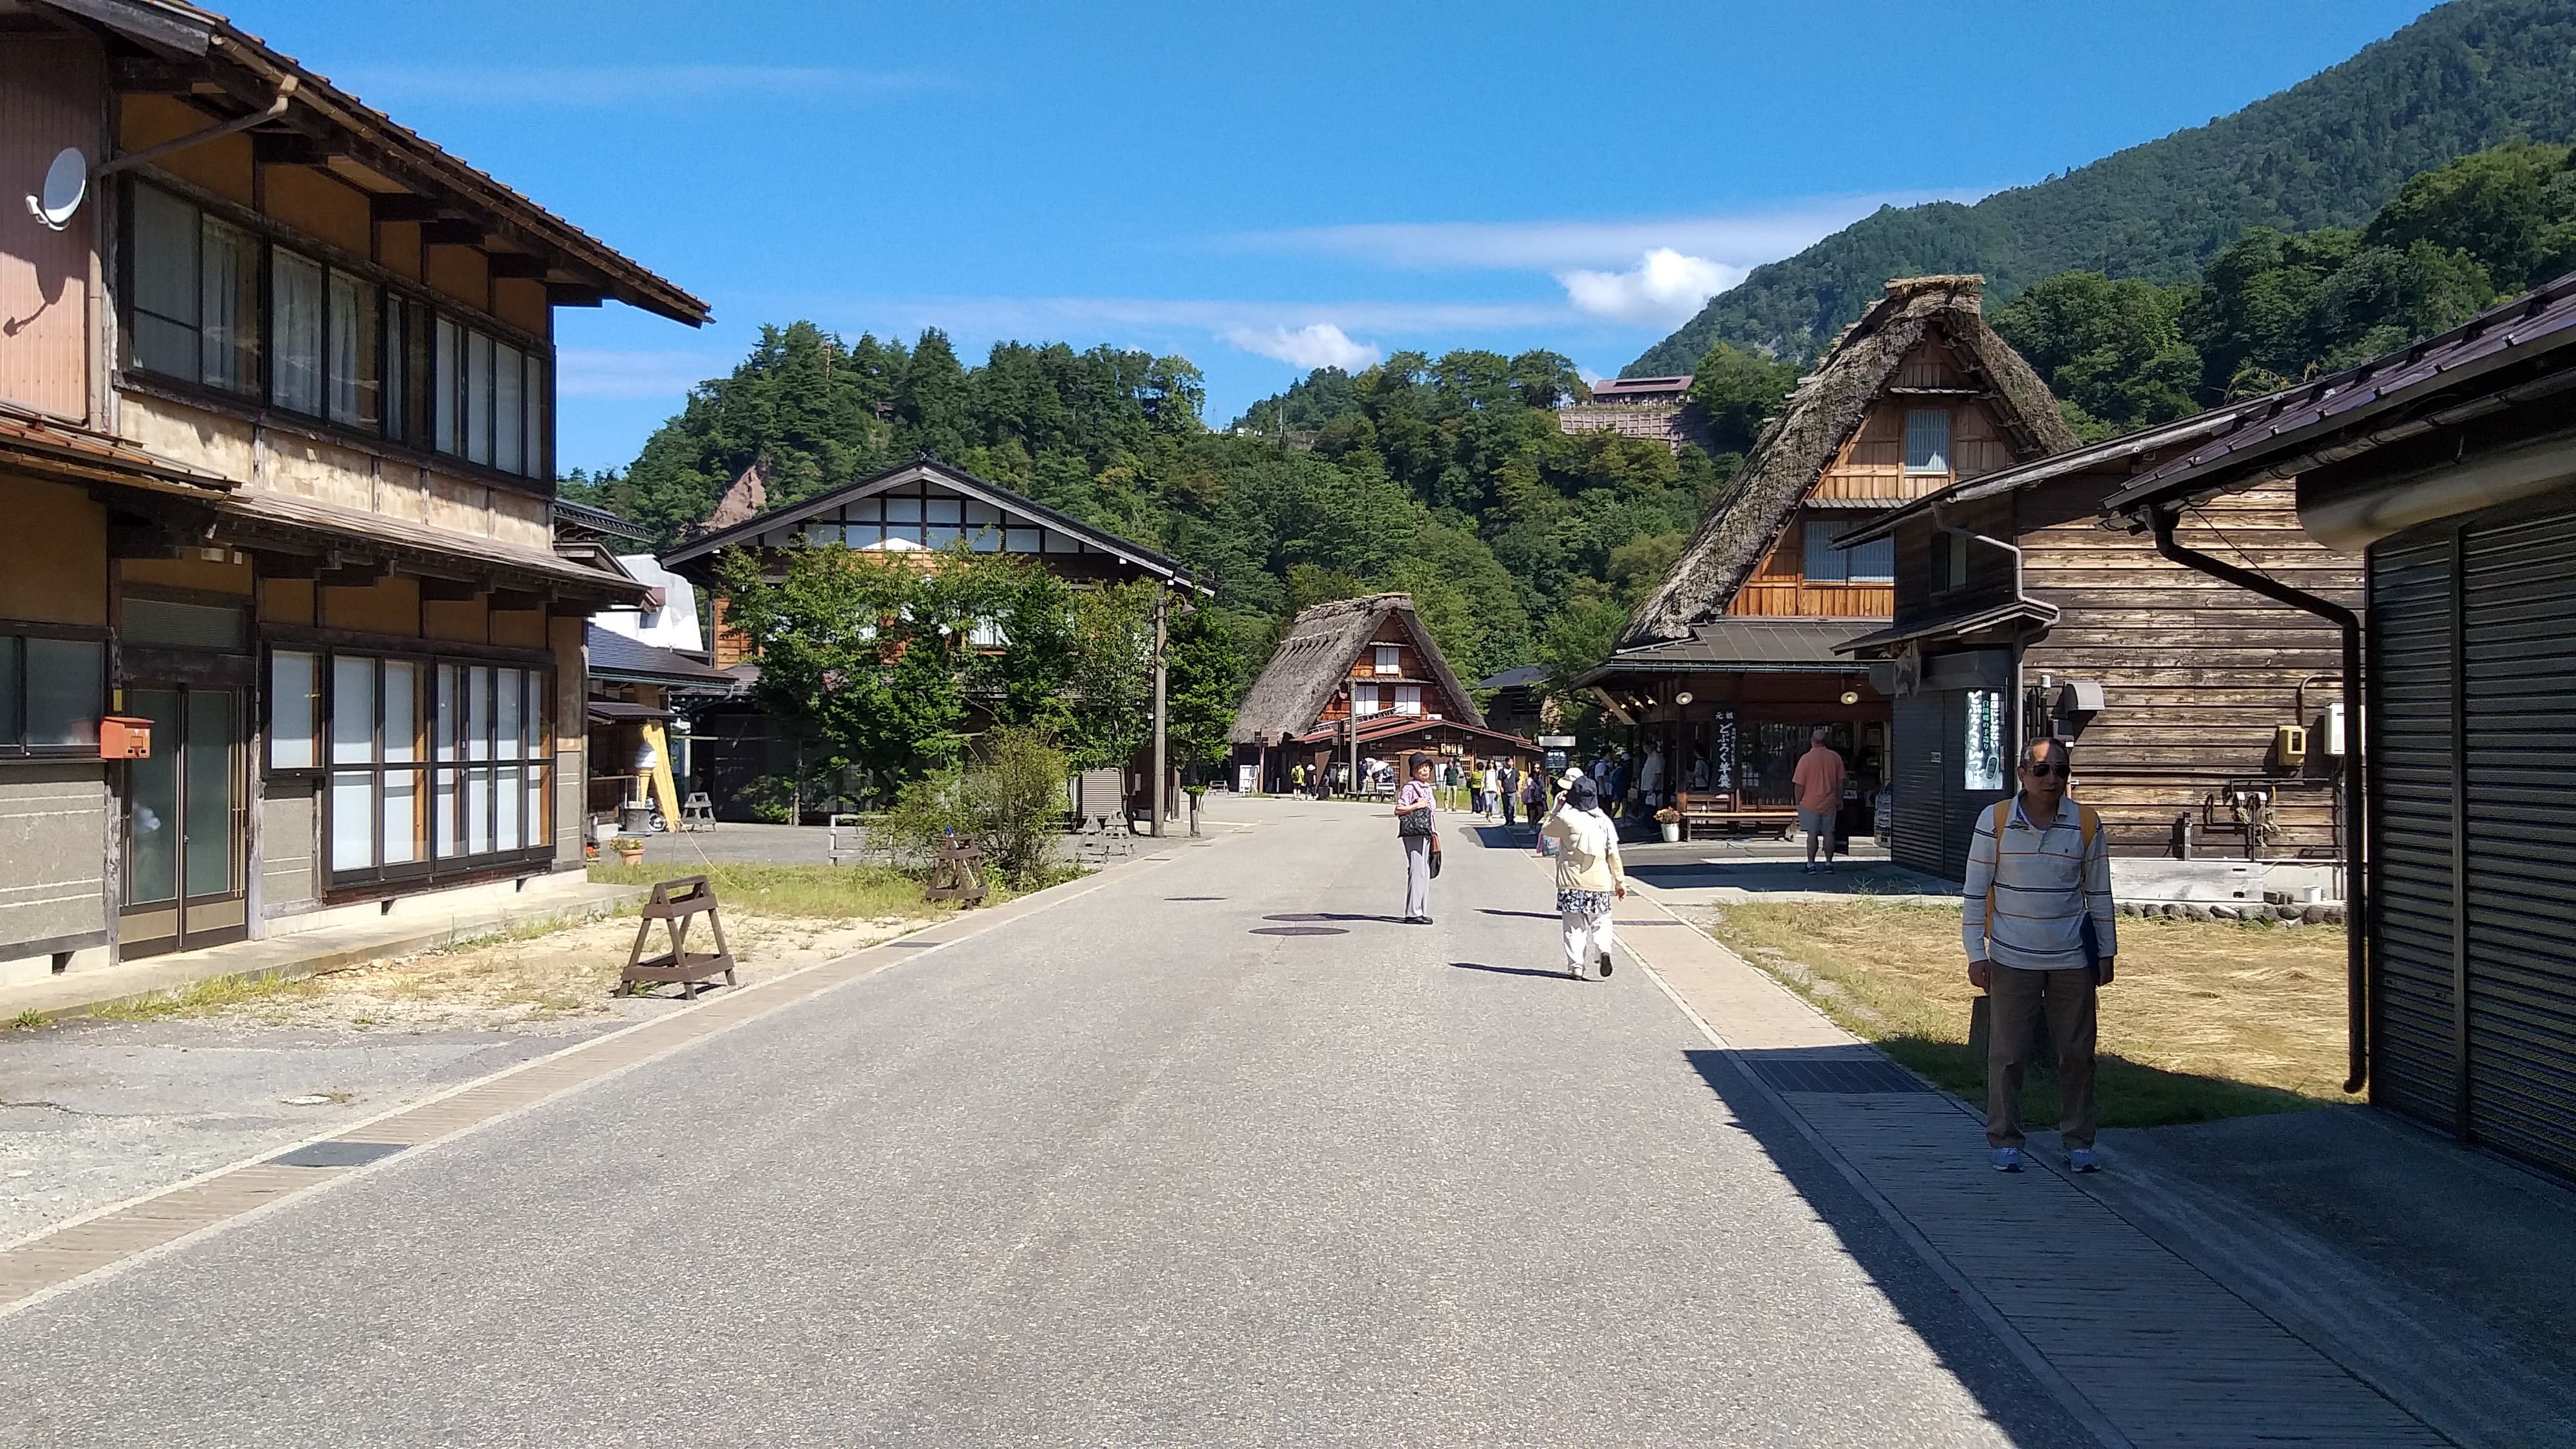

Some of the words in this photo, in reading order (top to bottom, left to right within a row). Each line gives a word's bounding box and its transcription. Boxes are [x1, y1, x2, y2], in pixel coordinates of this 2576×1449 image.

[1717, 722, 1734, 789] どぶろく羊羹
